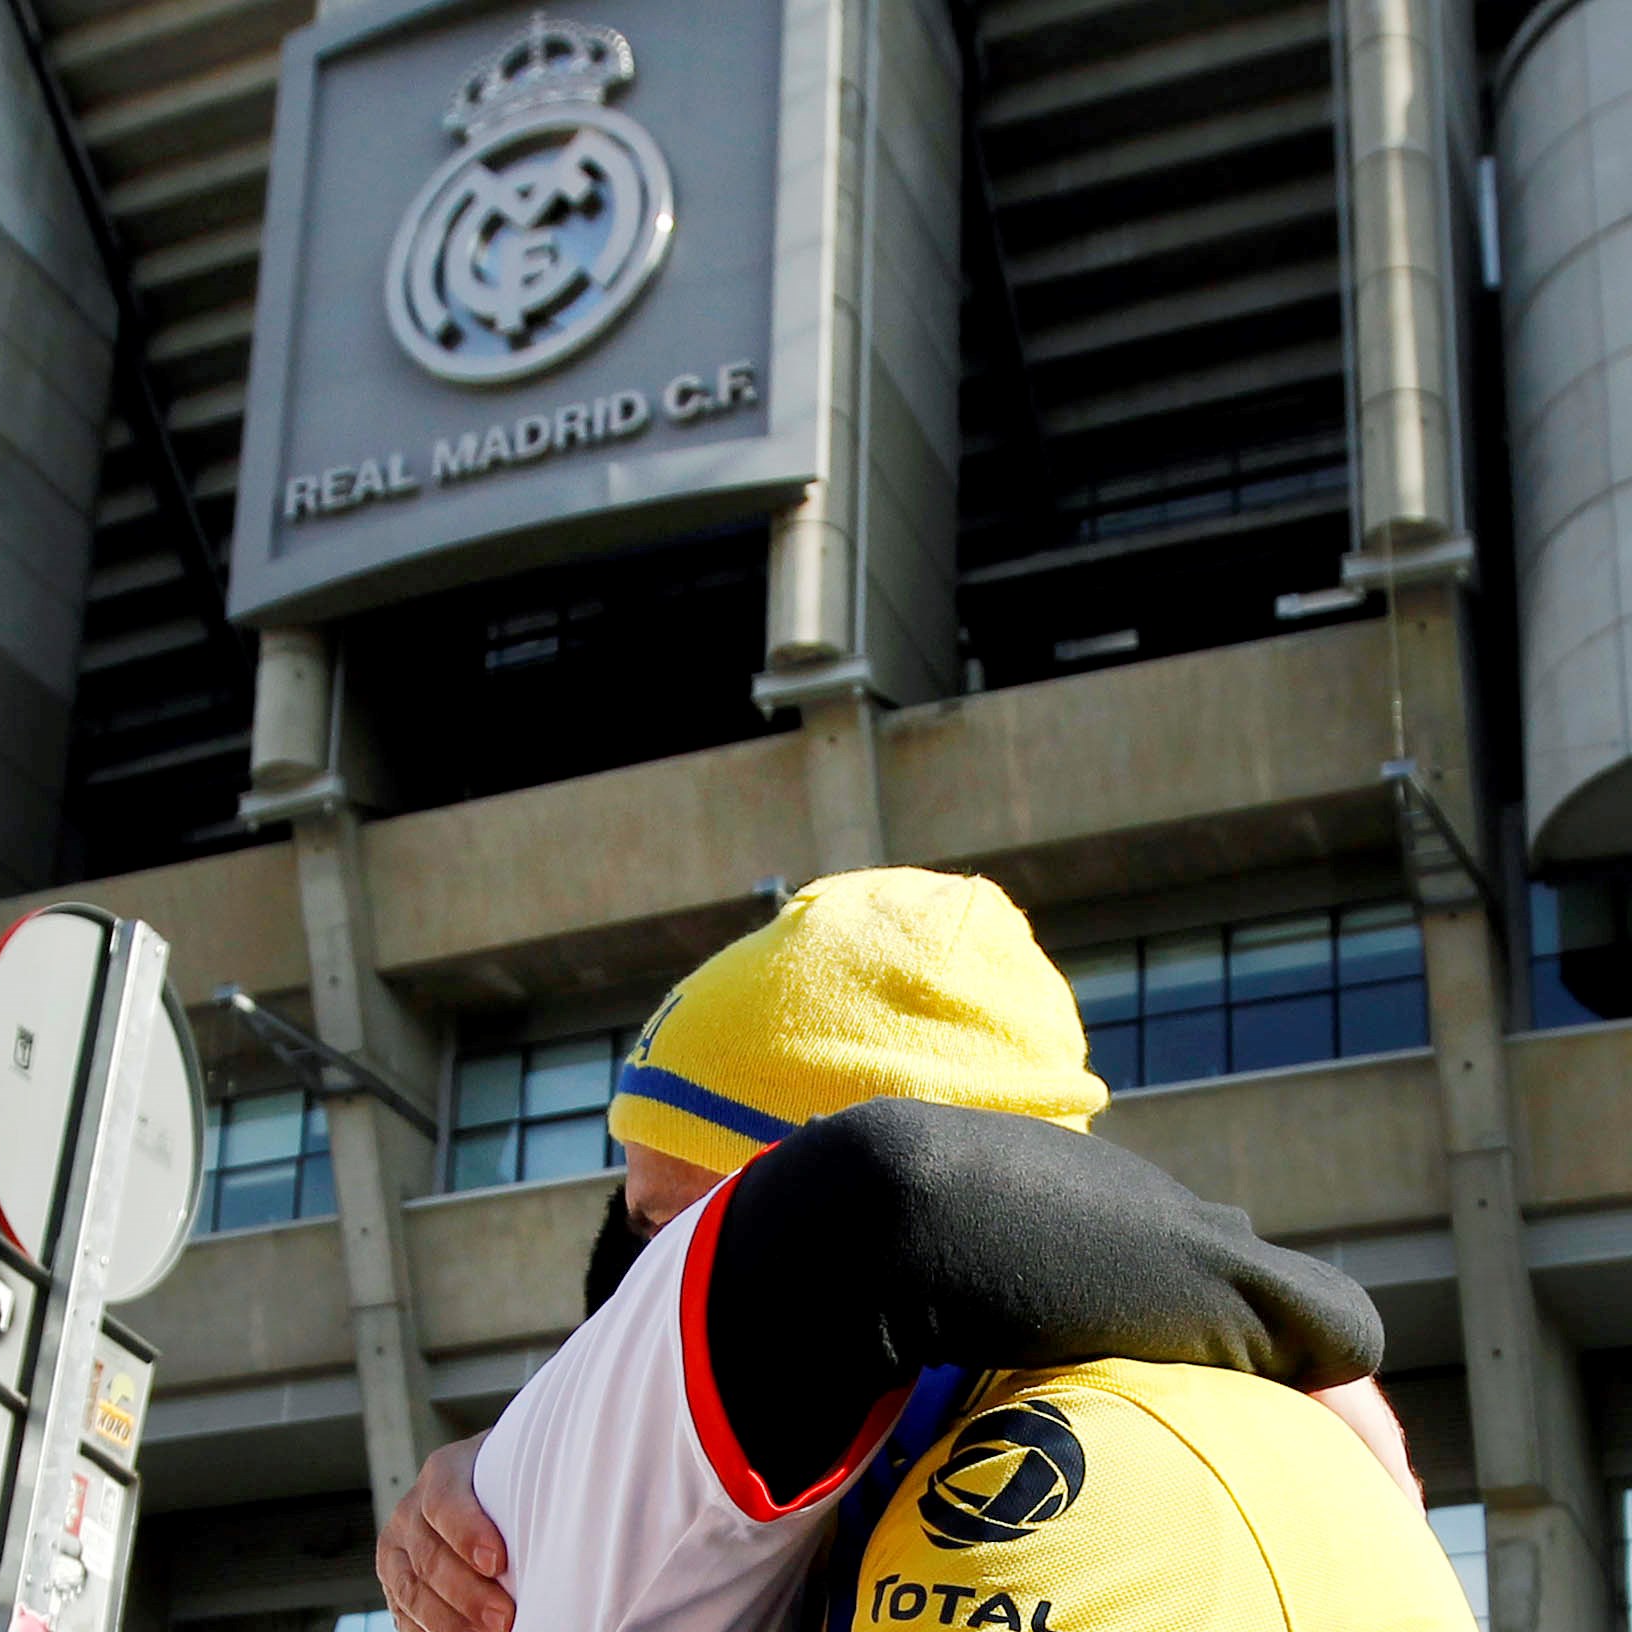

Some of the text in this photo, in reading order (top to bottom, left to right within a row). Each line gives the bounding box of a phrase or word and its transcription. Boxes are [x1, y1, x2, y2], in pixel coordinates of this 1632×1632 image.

[282, 359, 759, 519] REAL MADRID C.F.
